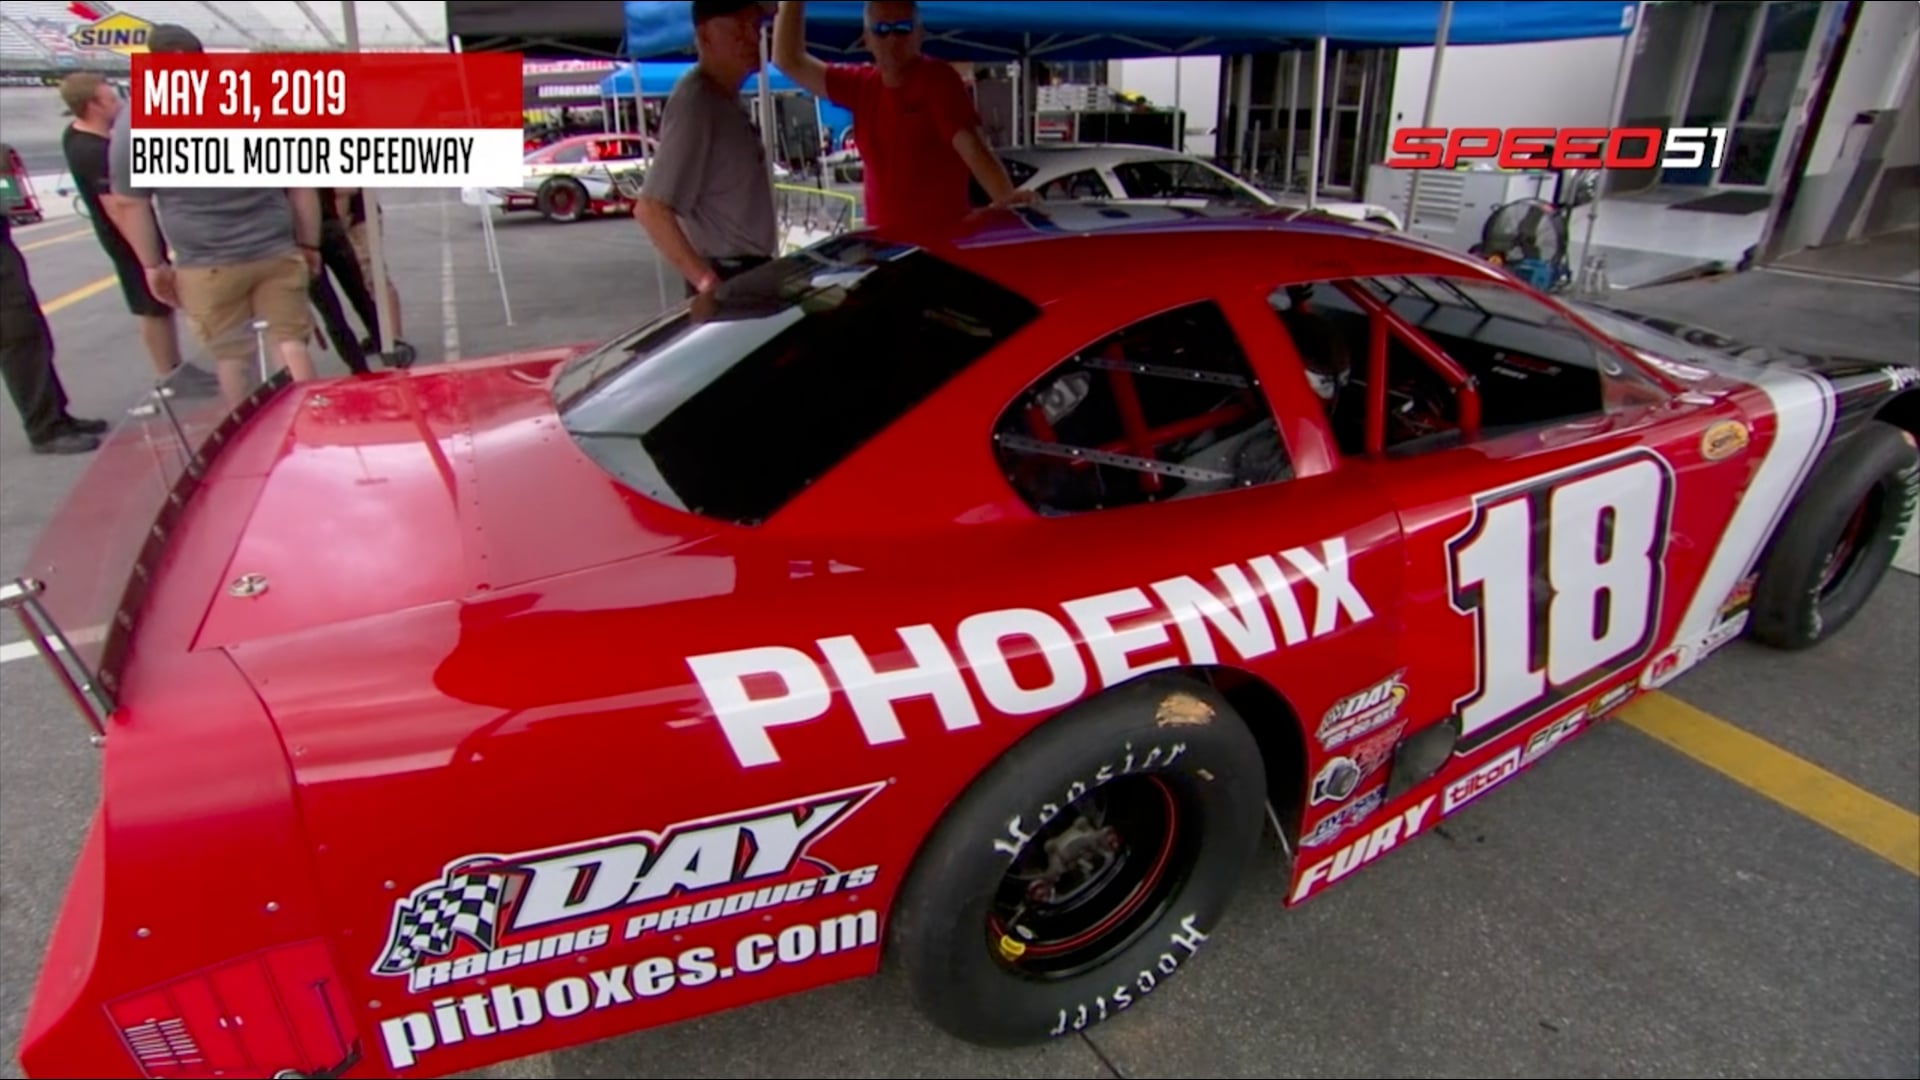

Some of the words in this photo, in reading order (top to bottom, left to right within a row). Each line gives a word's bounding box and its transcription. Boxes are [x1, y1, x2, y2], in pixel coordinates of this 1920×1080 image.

[685, 537, 1374, 768] PHOENIX
[1457, 459, 1663, 737] 18
[1449, 758, 1515, 804] tilton
[511, 797, 853, 930] DAY
[1291, 794, 1437, 903] FURY
[380, 909, 879, 1069] pitboxes.com
[413, 922, 612, 990] RACING
[624, 864, 879, 939] PRODUCTS
[1050, 912, 1210, 1036] Hoosier
